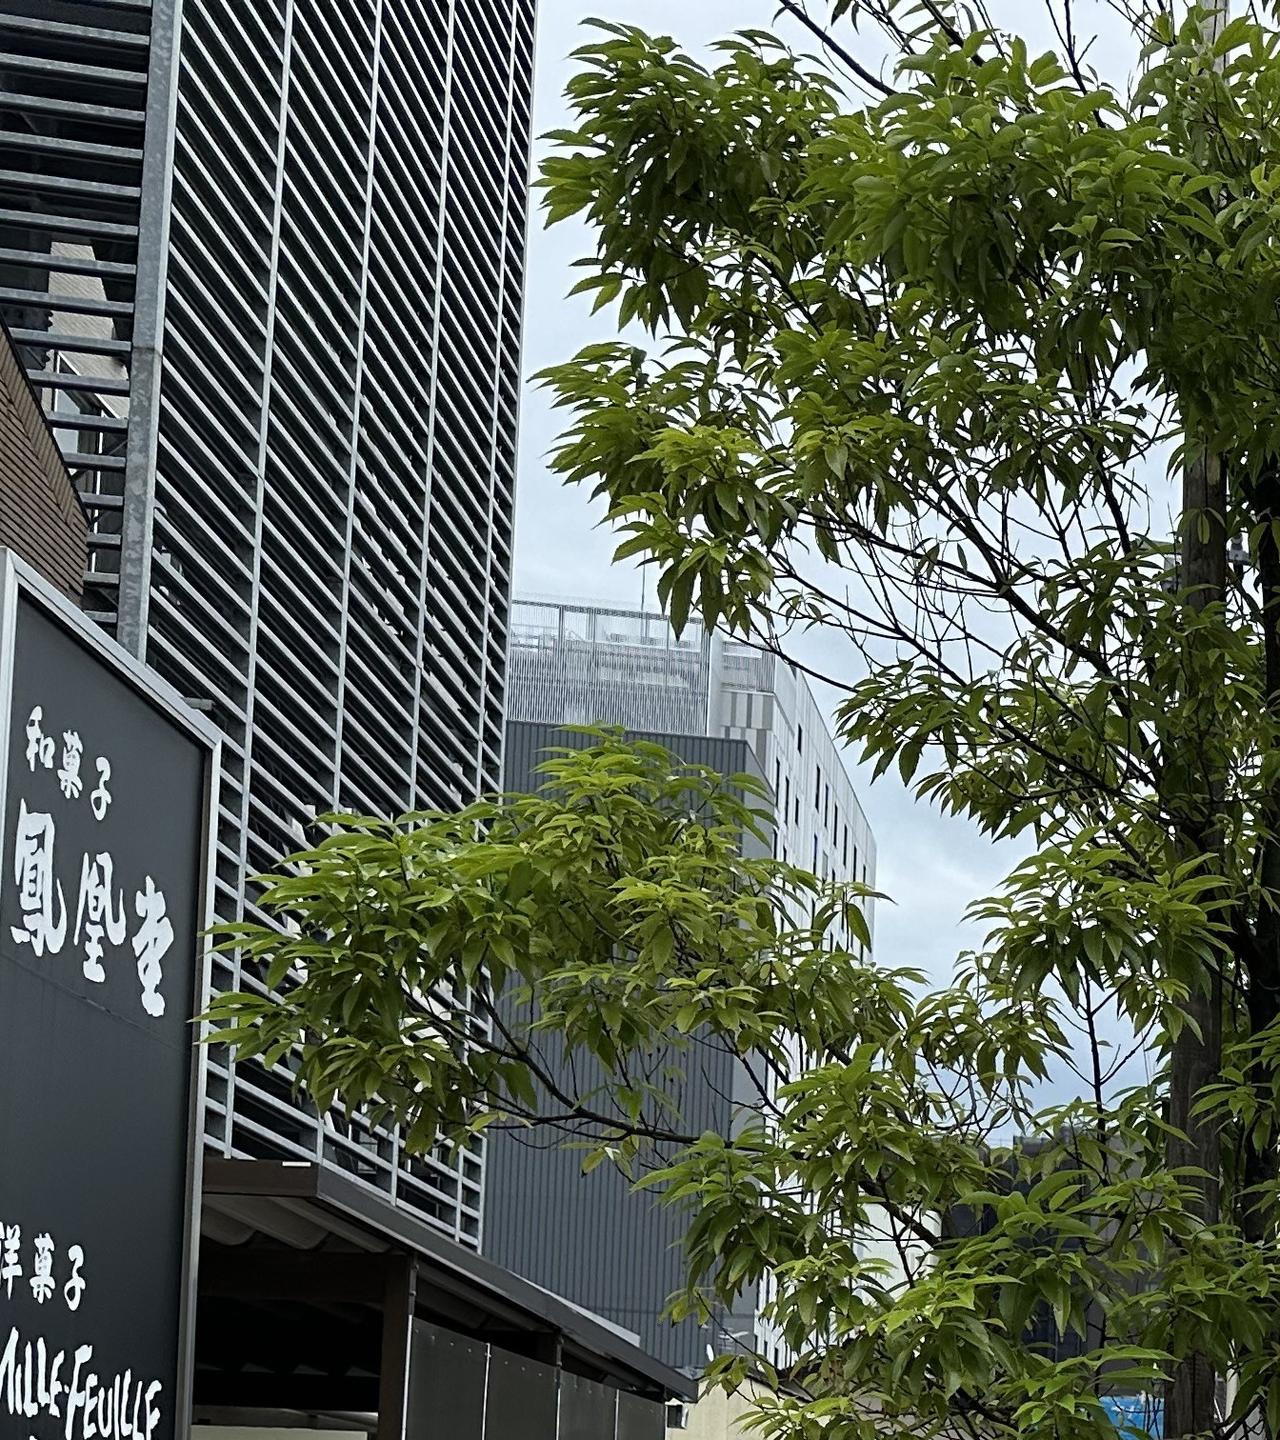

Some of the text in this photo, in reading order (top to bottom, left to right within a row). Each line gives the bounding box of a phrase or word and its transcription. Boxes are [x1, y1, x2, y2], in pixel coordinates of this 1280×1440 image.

[26, 705, 112, 821] 和菓子
[10, 797, 175, 1018] 鳳凰堂
